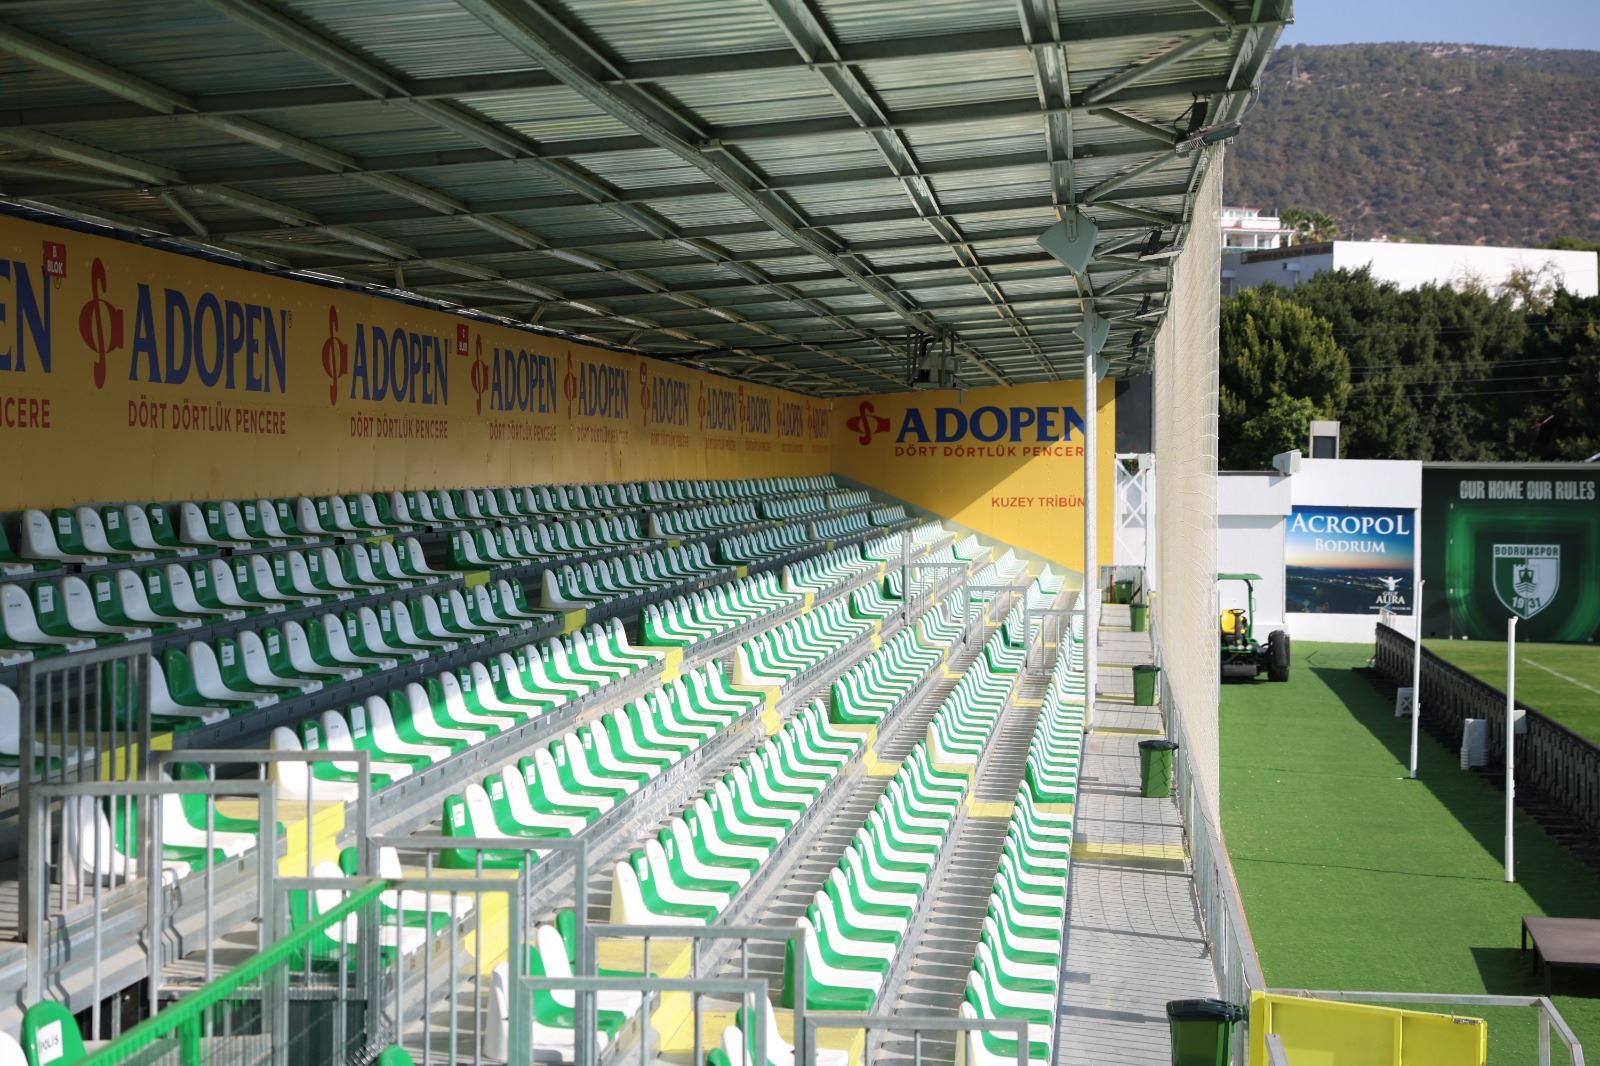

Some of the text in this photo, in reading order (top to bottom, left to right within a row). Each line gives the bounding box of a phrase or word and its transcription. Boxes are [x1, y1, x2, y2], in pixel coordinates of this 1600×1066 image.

[52, 245, 58, 258] B
[47, 260, 64, 275] BLOK
[128, 282, 287, 394] ADOPEN
[350, 323, 450, 406] ADOPEN
[490, 347, 557, 415] ADOPEN
[577, 361, 629, 420] ADOPEN
[651, 376, 690, 426] ADOPEN
[706, 387, 737, 432] ADOPEN
[128, 394, 287, 435] DÖRT DÖRTLÜK PENCERE
[350, 411, 449, 440] DÖRT DÖRTLÜK PENCERE
[895, 406, 1085, 443] ADOPEN
[895, 446, 937, 458] DÖRT
[944, 445, 1017, 459] DÖRTLÜK
[1459, 480, 1596, 501] OUR HOME OUR RULES
[991, 497, 1034, 508] KUZEY
[1290, 513, 1410, 535] ACROPOL
[1314, 538, 1386, 553] BODRUM
[1494, 546, 1560, 556] BODRUMSPOR
[1375, 595, 1406, 605] AURA
[1511, 597, 1542, 610] 1931
